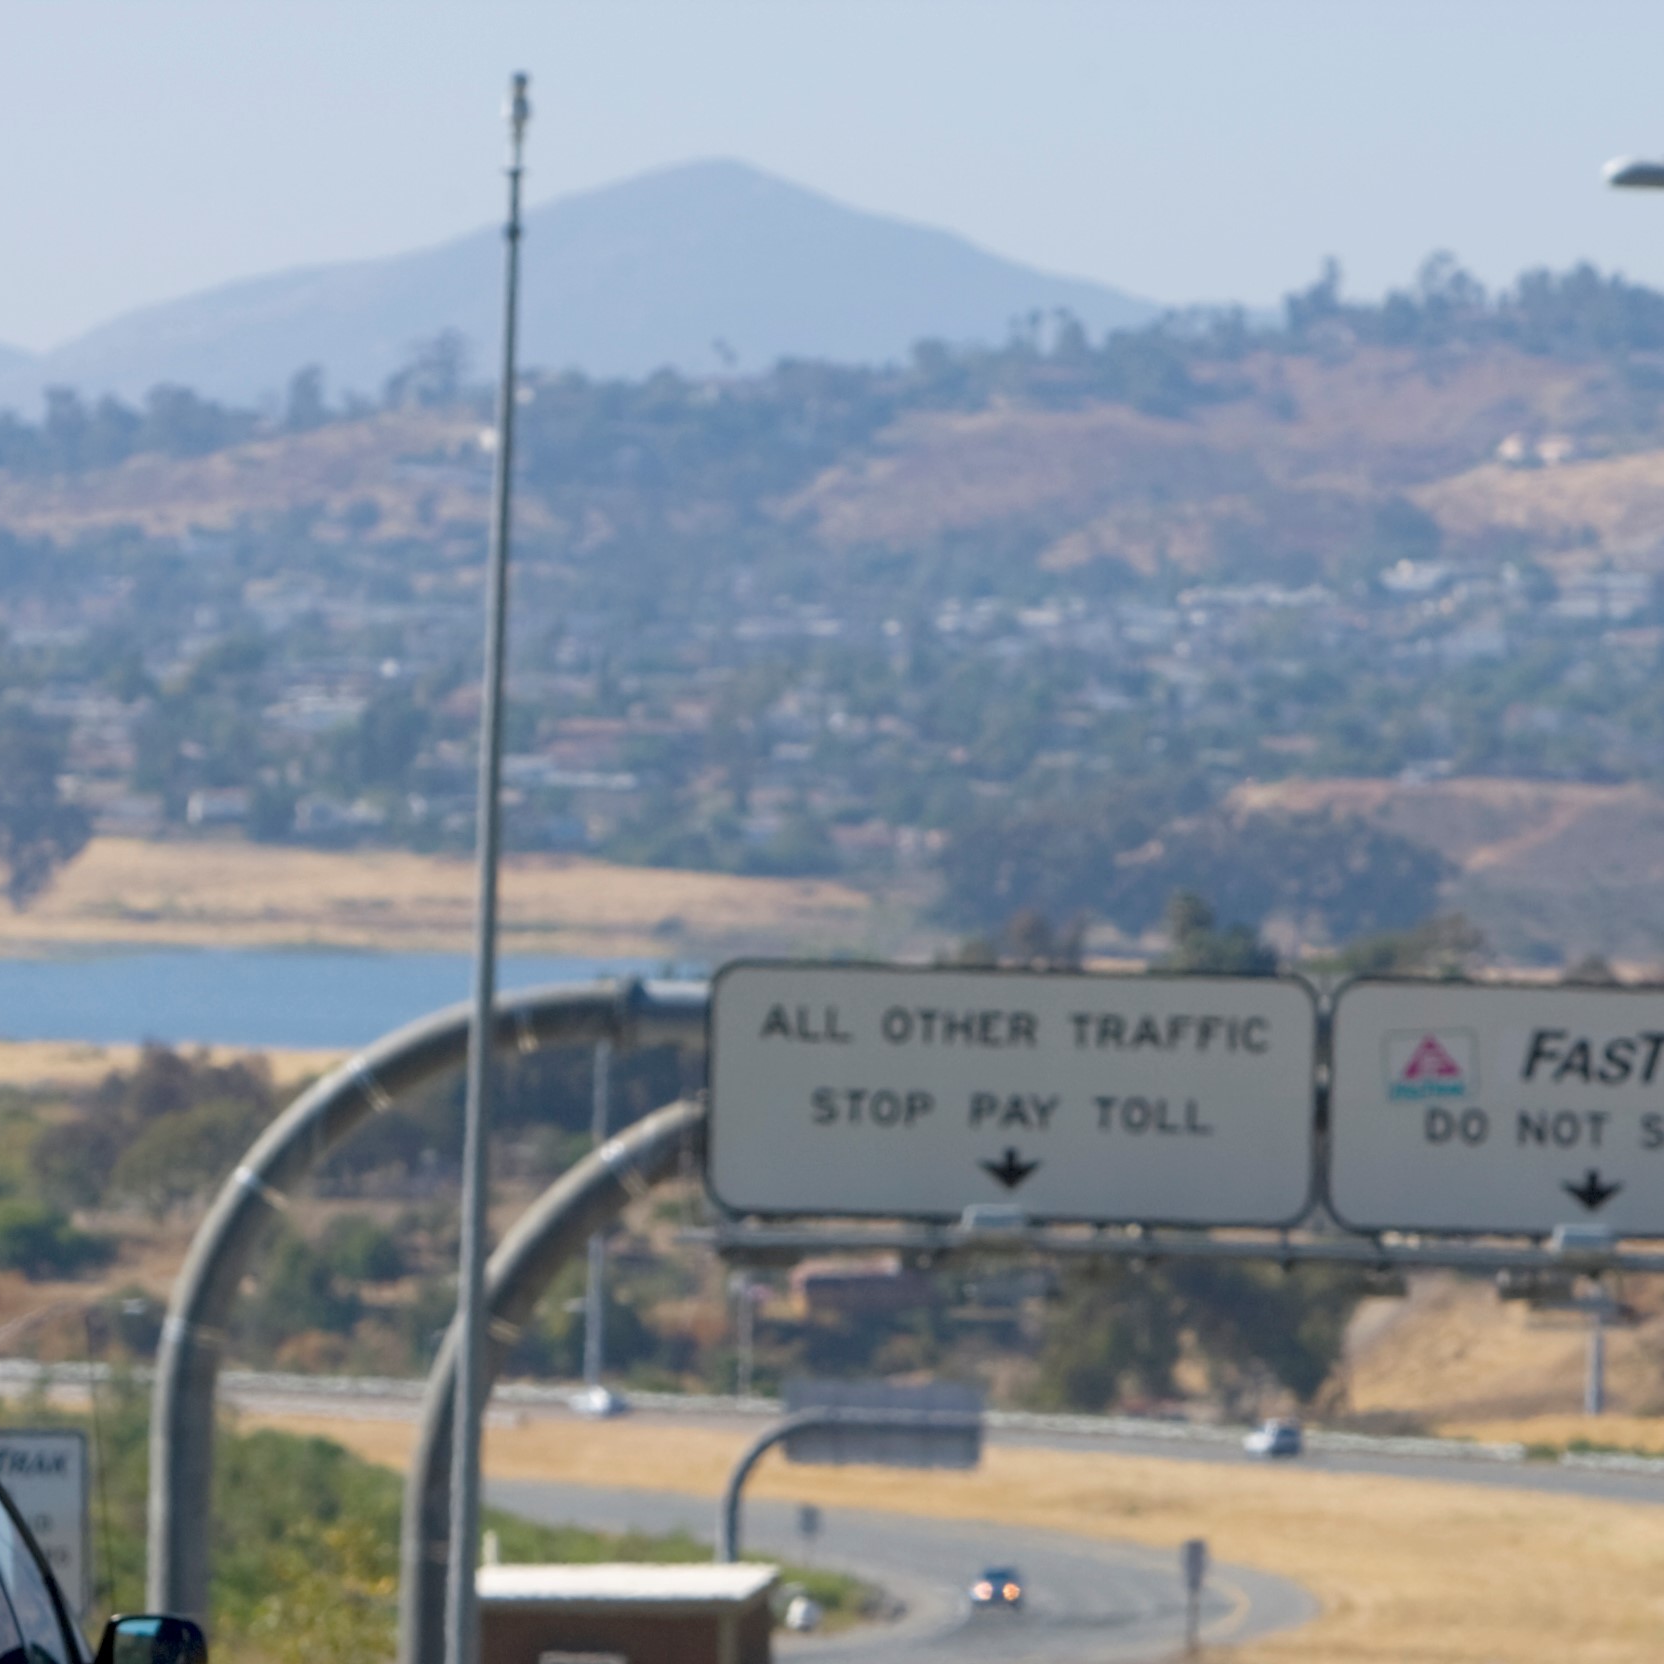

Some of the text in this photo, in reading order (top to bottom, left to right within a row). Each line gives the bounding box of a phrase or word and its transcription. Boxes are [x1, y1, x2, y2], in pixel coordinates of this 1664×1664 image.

[760, 1004, 1270, 1054] ALL OTHER TRAFFIC
[810, 1086, 1212, 1135] STOP PAY TOLL
[1424, 1108, 1489, 1146] DO
[1517, 1111, 1609, 1148] NOT
